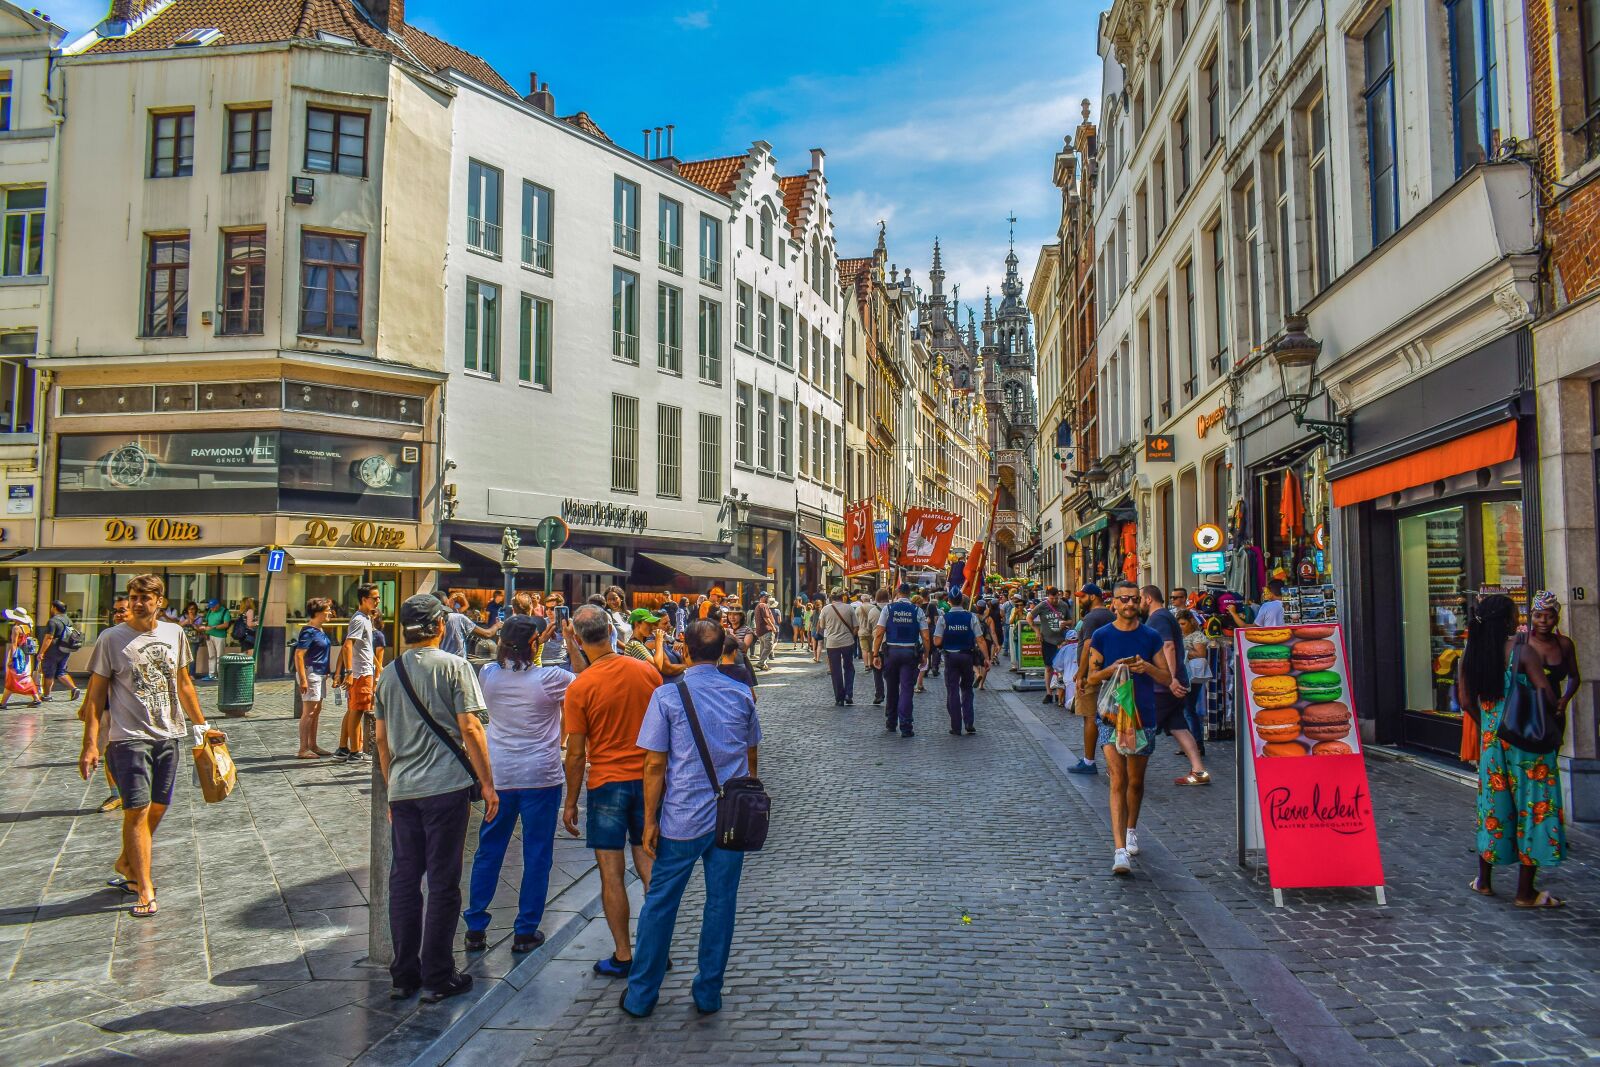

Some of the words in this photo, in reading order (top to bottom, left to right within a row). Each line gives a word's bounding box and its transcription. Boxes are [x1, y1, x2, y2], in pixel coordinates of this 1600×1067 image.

[191, 448, 241, 457] RAYMOND
[245, 447, 272, 456] WEIL
[294, 448, 324, 457] RAYMOND
[564, 497, 593, 519] Maison
[105, 517, 138, 541] De
[146, 518, 203, 541] Witte
[305, 519, 339, 542] De
[350, 520, 406, 547] Witte
[934, 522, 952, 534] 49
[1572, 587, 1585, 601] 19
[1264, 786, 1309, 831] Pierre
